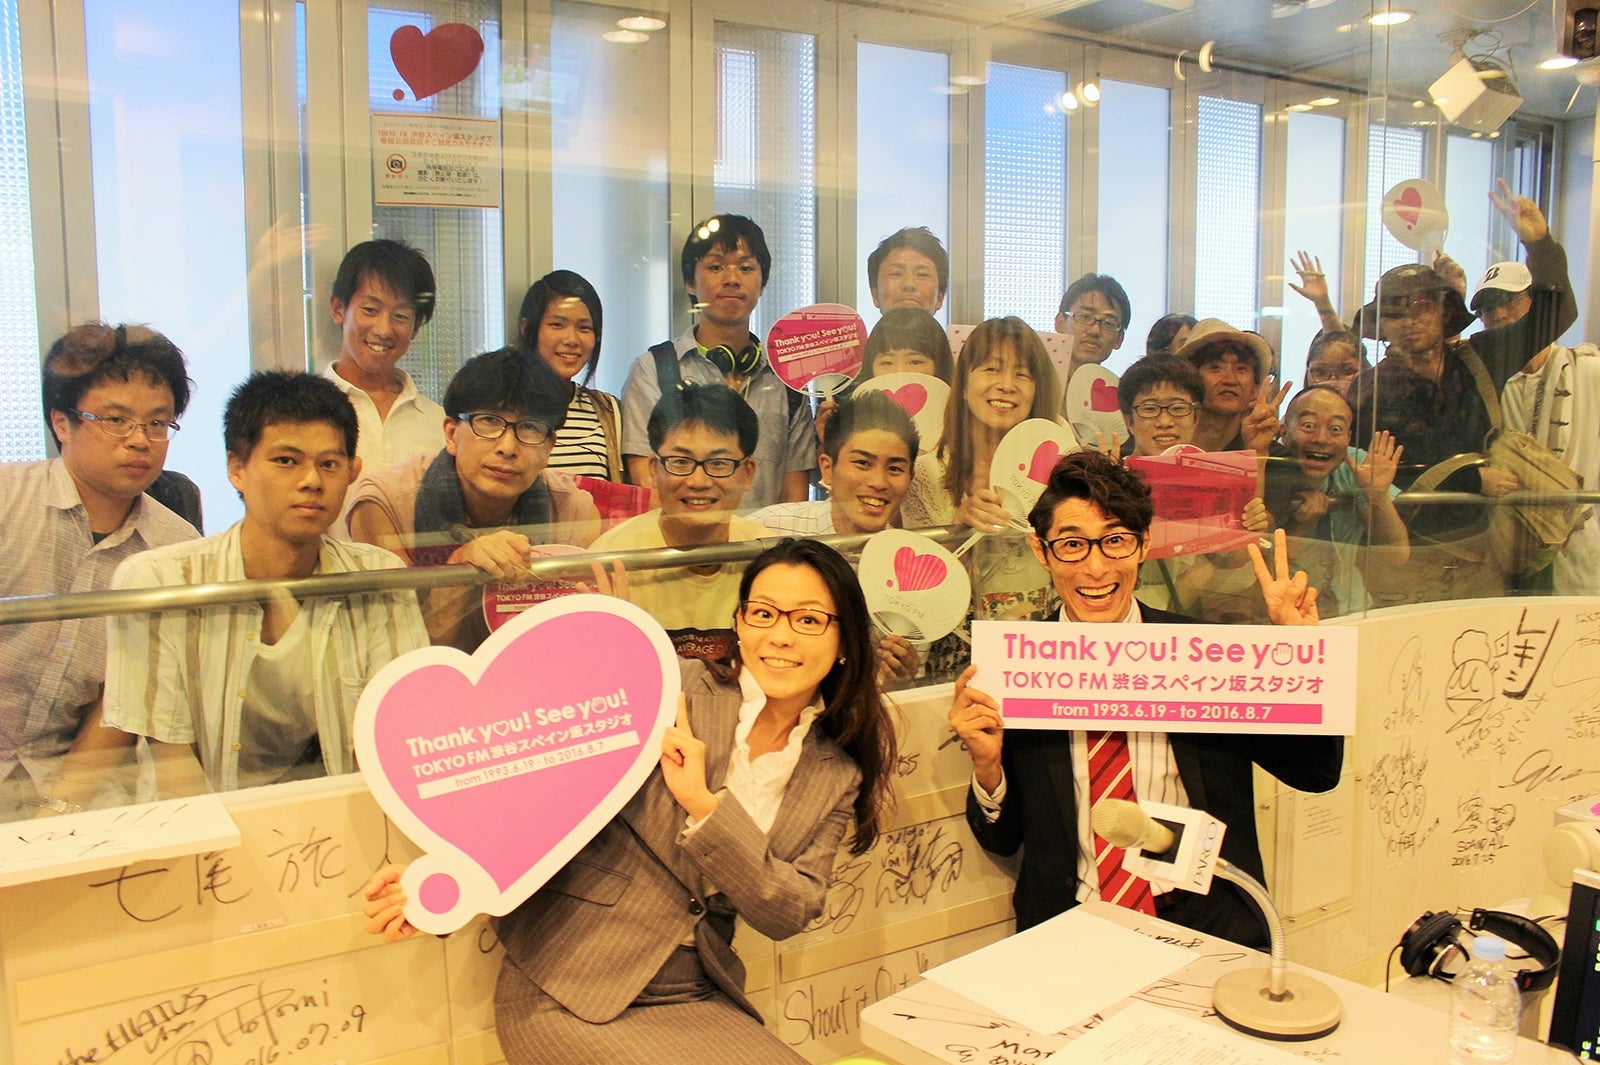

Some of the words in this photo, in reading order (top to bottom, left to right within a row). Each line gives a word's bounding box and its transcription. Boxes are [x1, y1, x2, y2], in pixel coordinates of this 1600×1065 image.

[775, 335, 801, 348] Thank
[821, 328, 837, 338] See
[1003, 633, 1098, 661] Thank
[1188, 637, 1245, 662] See
[1003, 671, 1074, 689] TOKYO
[1079, 672, 1108, 690] FM
[1112, 673, 1324, 695] 渋谷スペイン坂スタジオ
[1052, 702, 1089, 717] from
[1092, 703, 1167, 719] 1993.6.19
[1180, 704, 1197, 719] to
[1199, 705, 1272, 720] 2016.8.7
[406, 726, 478, 758] Thank
[535, 704, 577, 727] See
[412, 755, 466, 779] TOKYO
[467, 749, 491, 764] FM
[490, 712, 633, 759] 渋谷スペイン坂スタジオ
[455, 774, 481, 788] from
[483, 759, 535, 780] 1993.6.19
[544, 755, 556, 765] to
[559, 741, 605, 761] 2016.8.7
